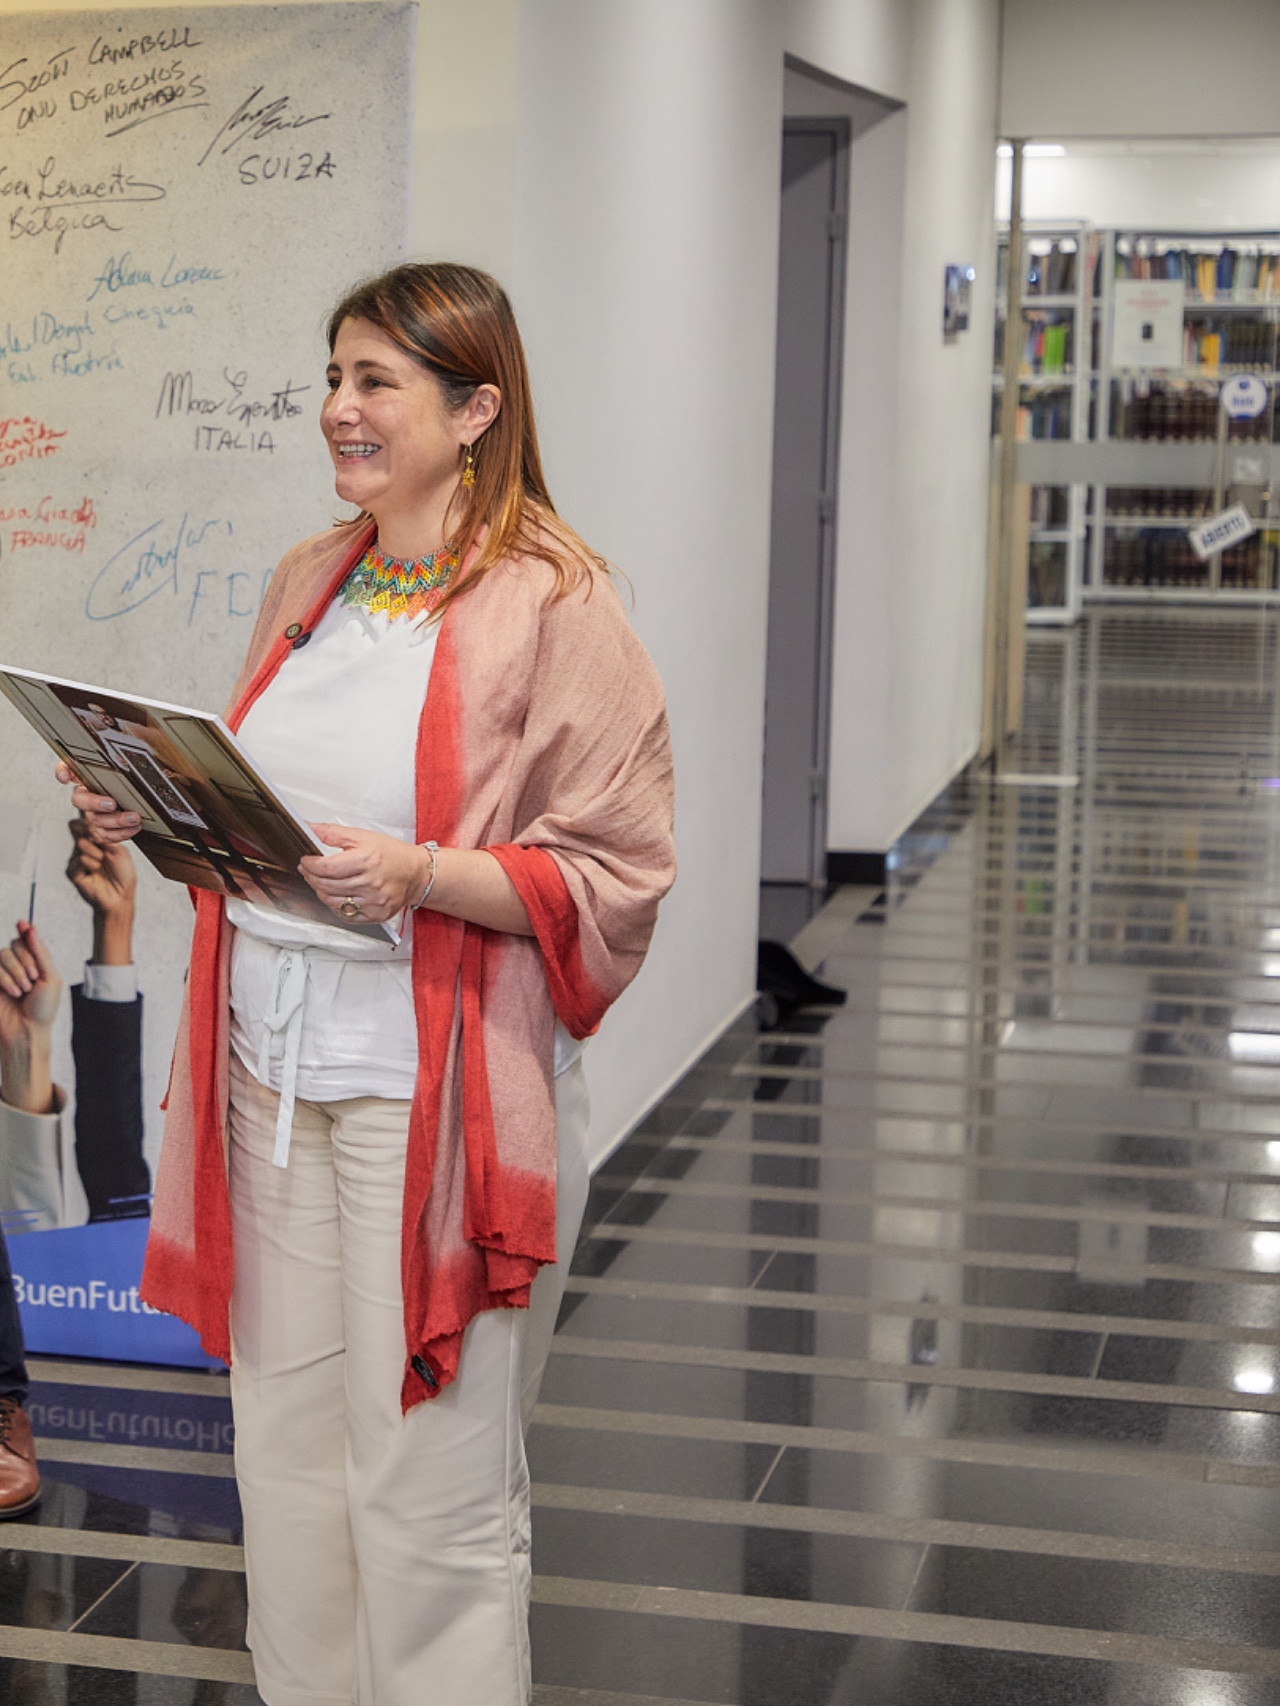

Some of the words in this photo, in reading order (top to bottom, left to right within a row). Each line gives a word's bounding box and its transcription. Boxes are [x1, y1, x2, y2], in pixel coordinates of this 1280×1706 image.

[88, 26, 203, 65] CAMPBELL
[18, 102, 57, 129] ONU
[70, 60, 185, 112] DERECHOS
[238, 151, 337, 185] SUIZA
[194, 425, 277, 454] ITALIA
